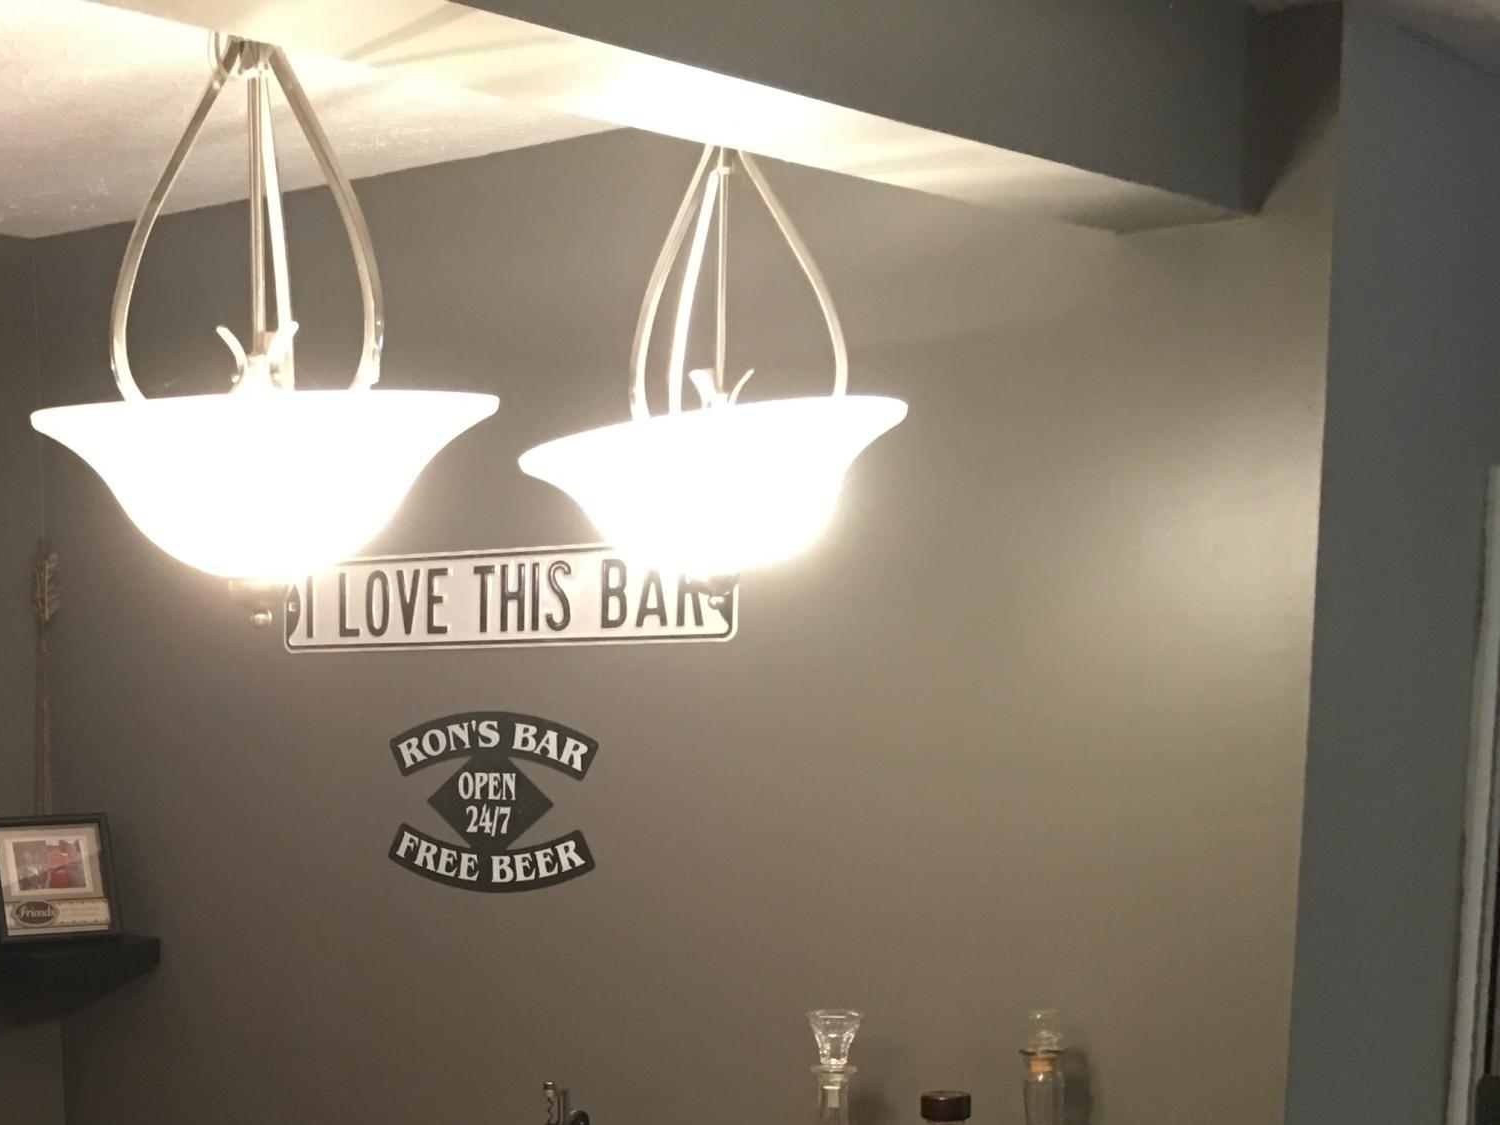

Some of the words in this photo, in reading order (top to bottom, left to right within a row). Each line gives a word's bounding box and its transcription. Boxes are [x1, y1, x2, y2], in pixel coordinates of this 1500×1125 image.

[306, 575, 314, 639] I
[339, 567, 448, 637] LOVE
[473, 560, 572, 633] THIS
[601, 558, 705, 629] BAR
[397, 720, 500, 769] RON'S
[511, 722, 588, 772] BAR
[458, 771, 517, 801] OPEN
[465, 803, 512, 837] 24/7
[395, 831, 480, 882] FREE
[490, 839, 586, 884] BEER
